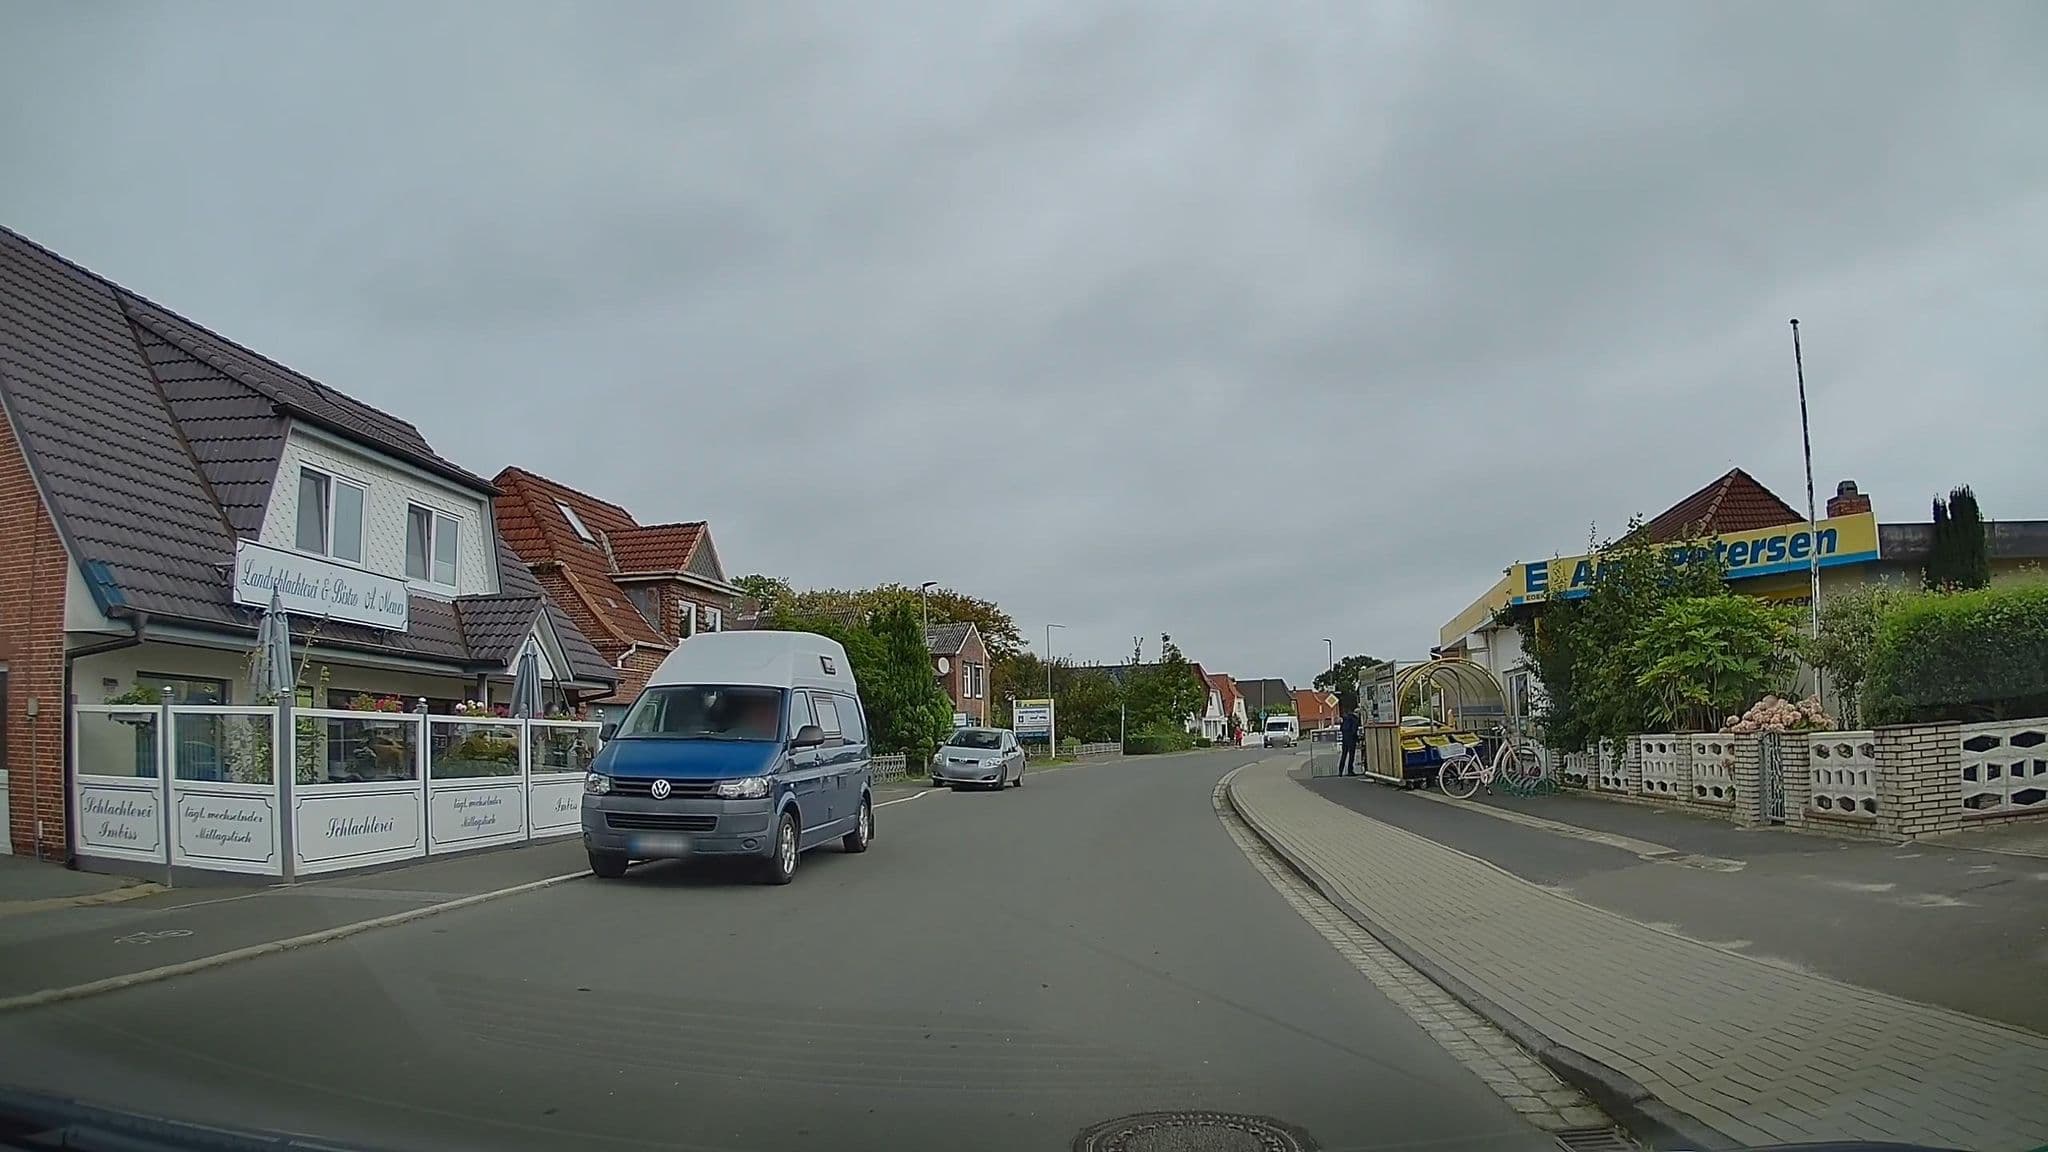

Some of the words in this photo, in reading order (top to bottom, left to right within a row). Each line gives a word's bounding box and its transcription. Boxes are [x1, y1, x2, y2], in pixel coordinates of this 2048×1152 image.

[84, 796, 153, 818] Schlachterei
[98, 822, 138, 840] Imbiss
[326, 815, 394, 838] Schlachterei
